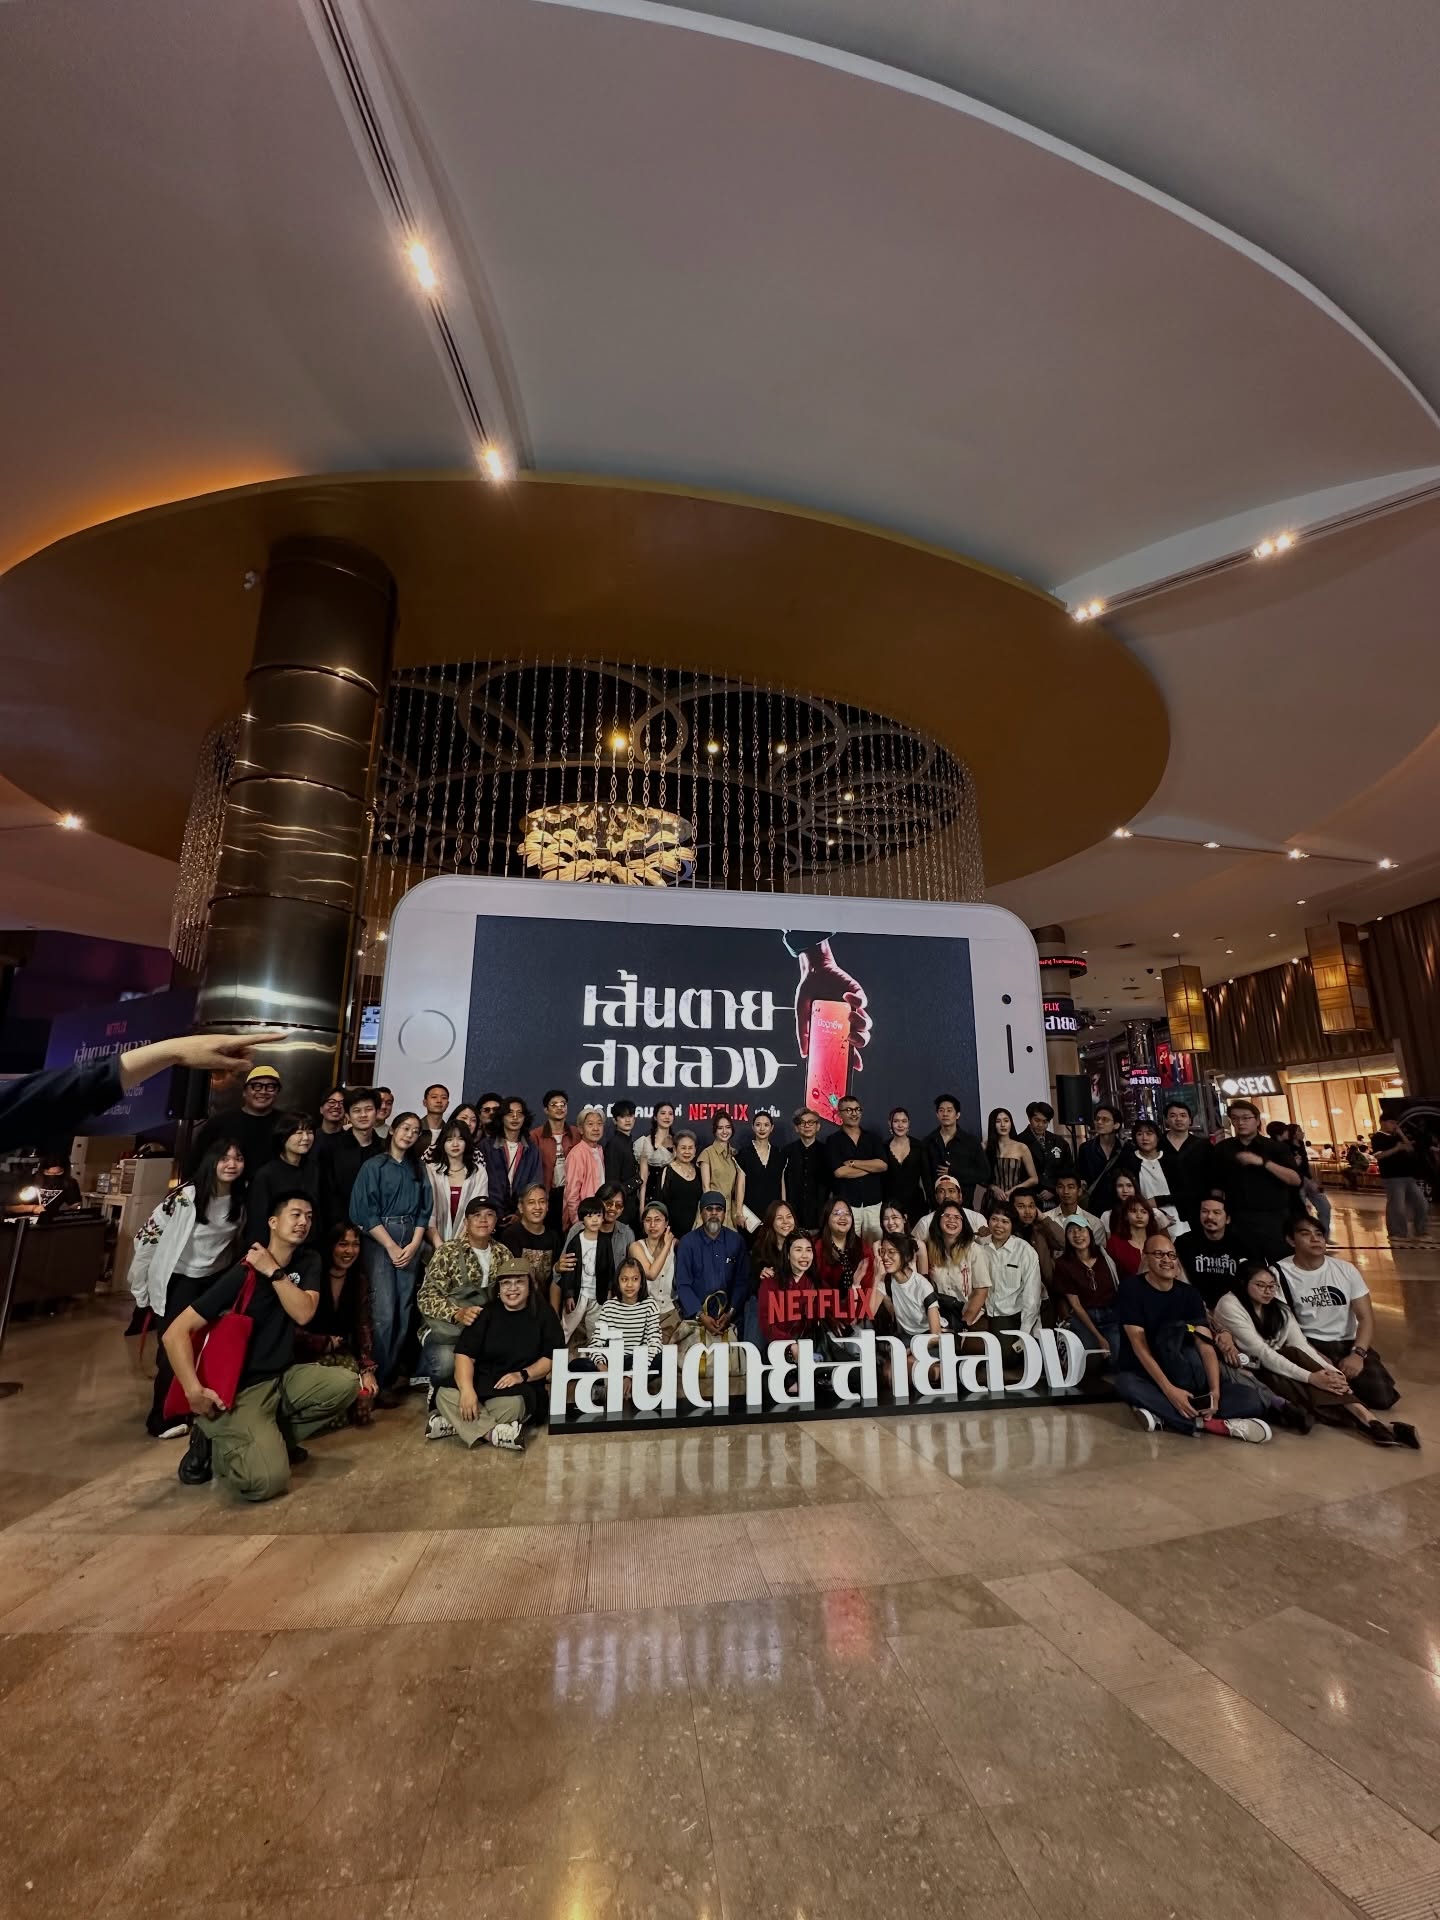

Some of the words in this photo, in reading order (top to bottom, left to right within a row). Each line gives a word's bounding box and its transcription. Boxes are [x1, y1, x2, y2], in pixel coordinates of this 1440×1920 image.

[583, 969, 796, 1031] เส้นตาย
[580, 1039, 798, 1089] สายลวง
[1237, 1075, 1276, 1095] SEKI
[1300, 1292, 1331, 1304] NORTH
[1311, 1286, 1328, 1295] THE
[768, 1287, 875, 1325] NETFLIX
[1311, 1299, 1333, 1308] FACE
